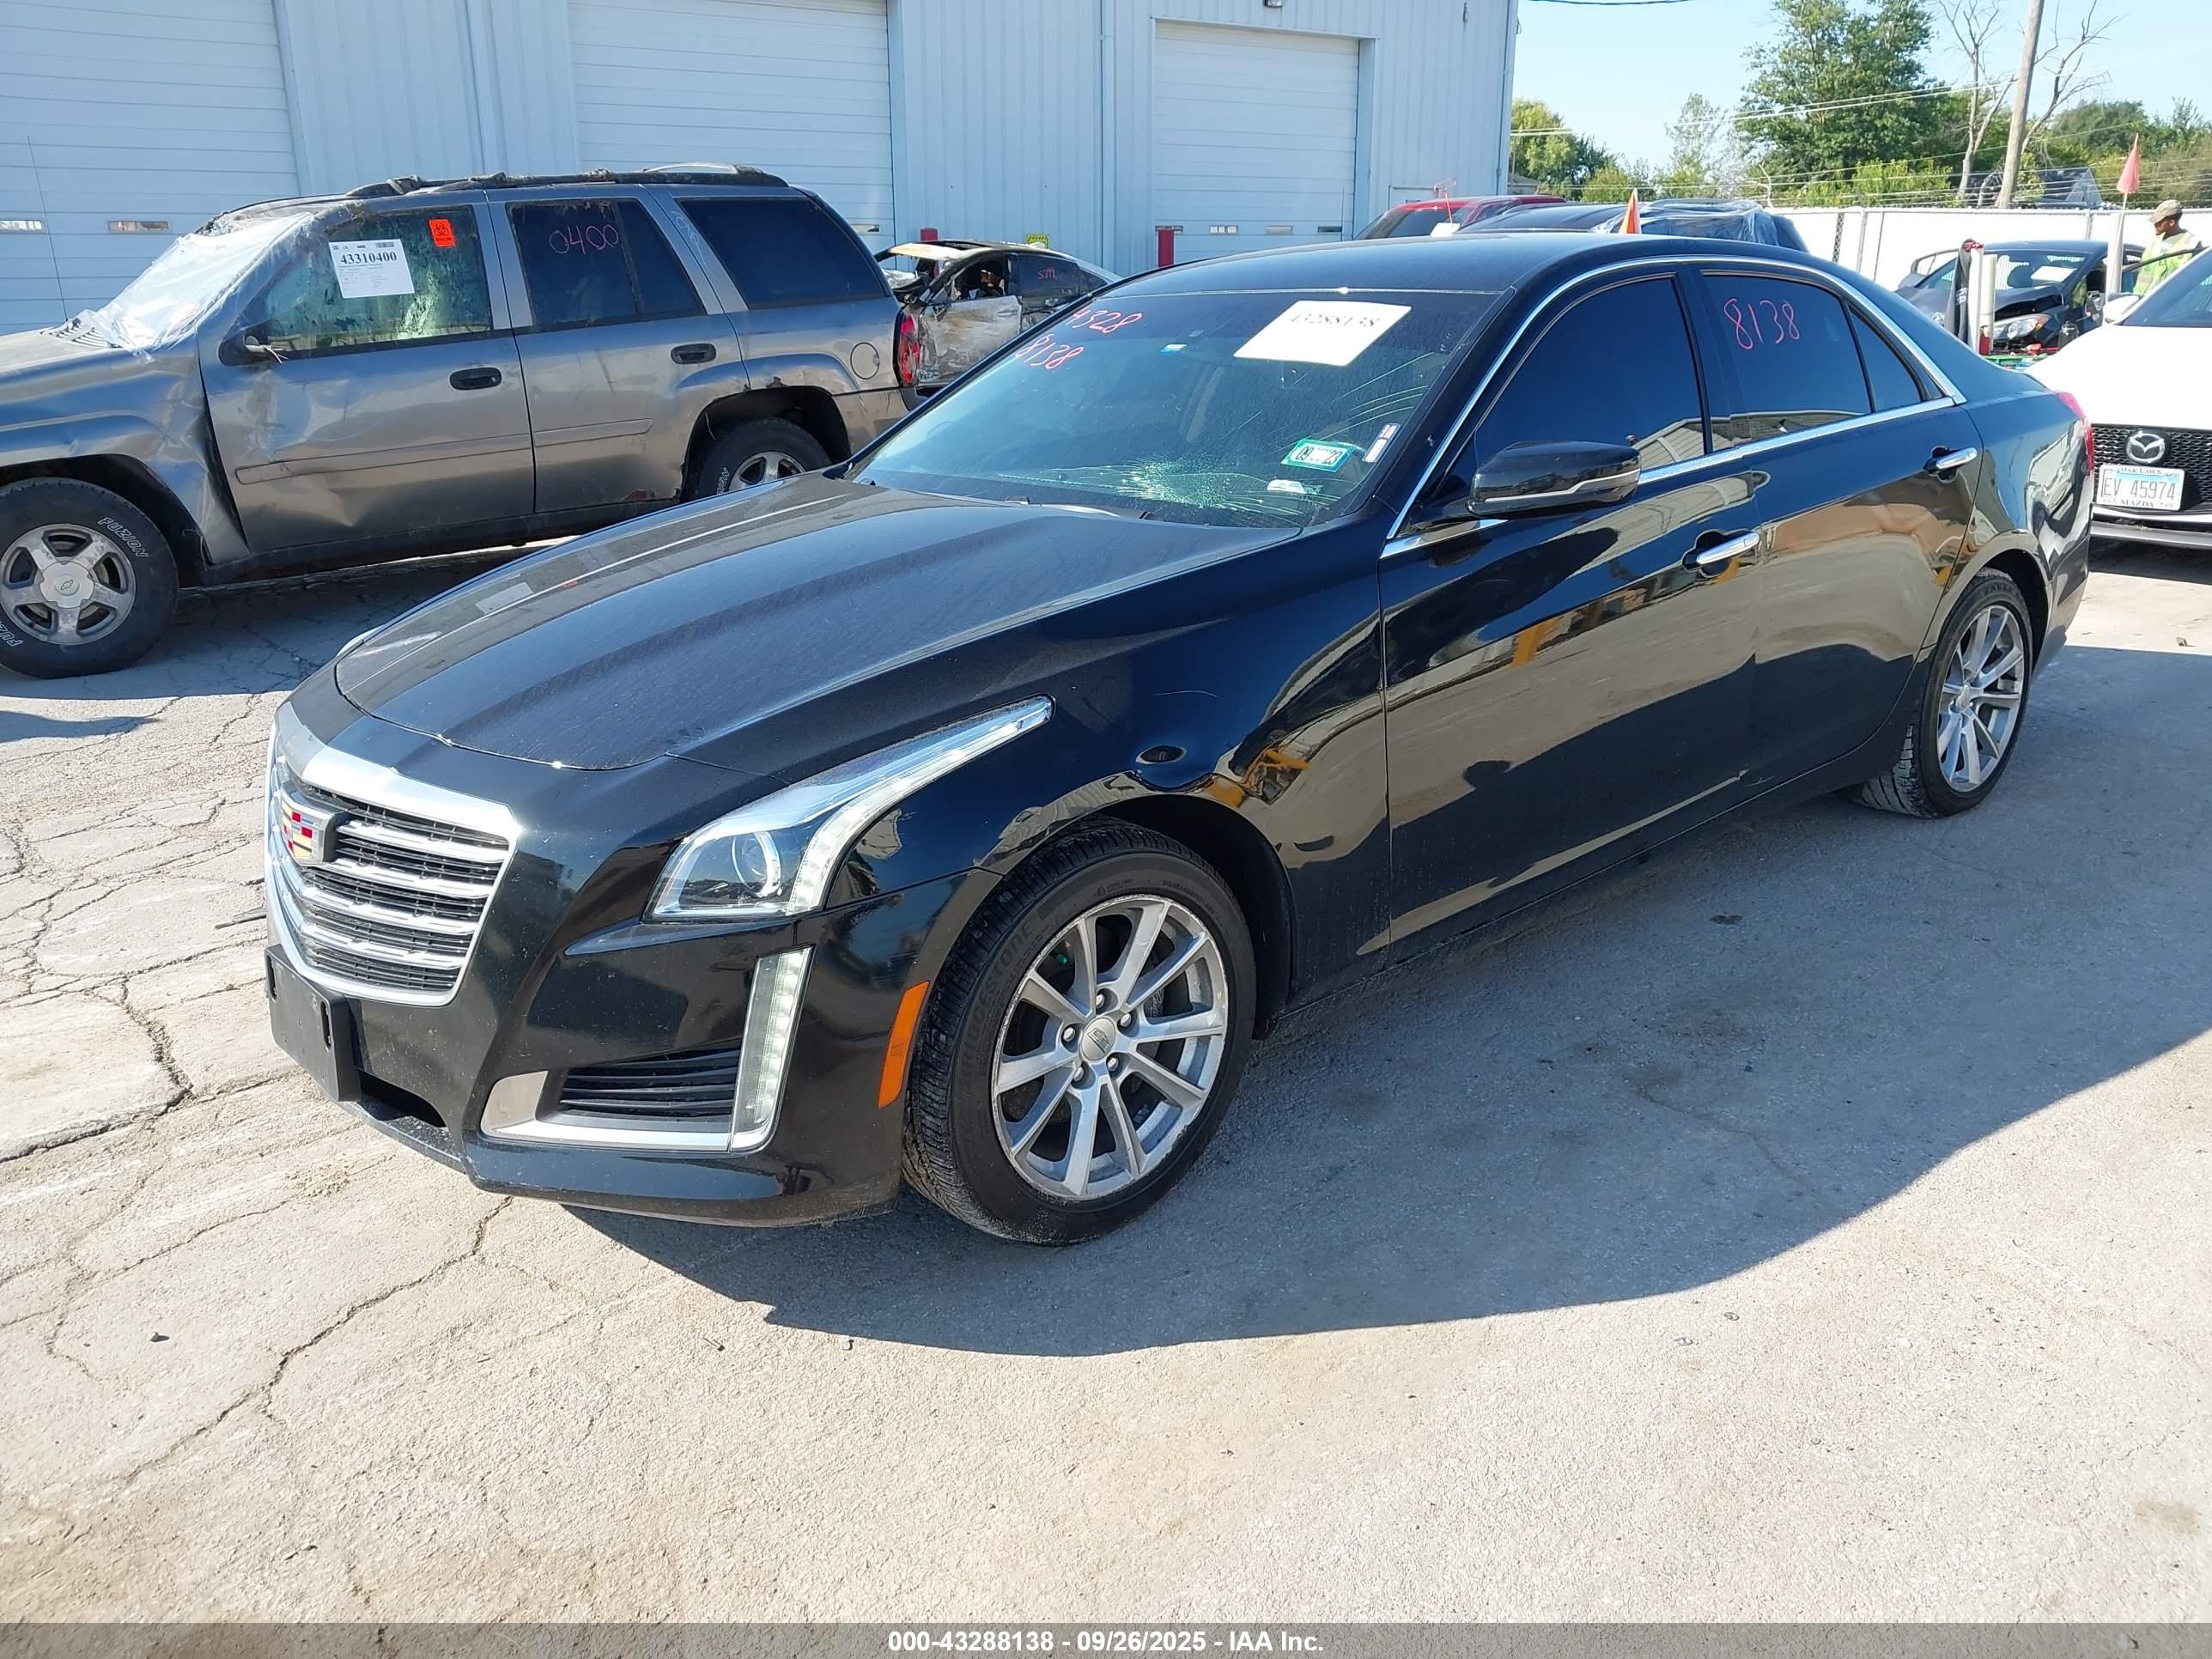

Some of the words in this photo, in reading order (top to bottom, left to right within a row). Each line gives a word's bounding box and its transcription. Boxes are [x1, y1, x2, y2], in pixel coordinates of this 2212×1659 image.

[550, 224, 619, 254] 0400
[340, 251, 398, 264] 43310400
[1723, 298, 1800, 349] 8138
[1015, 334, 1085, 369] 8138
[2104, 477, 2122, 495] EV
[2130, 479, 2176, 500] 45974
[2121, 499, 2154, 507] MAZDA
[97, 517, 149, 557] FUZION
